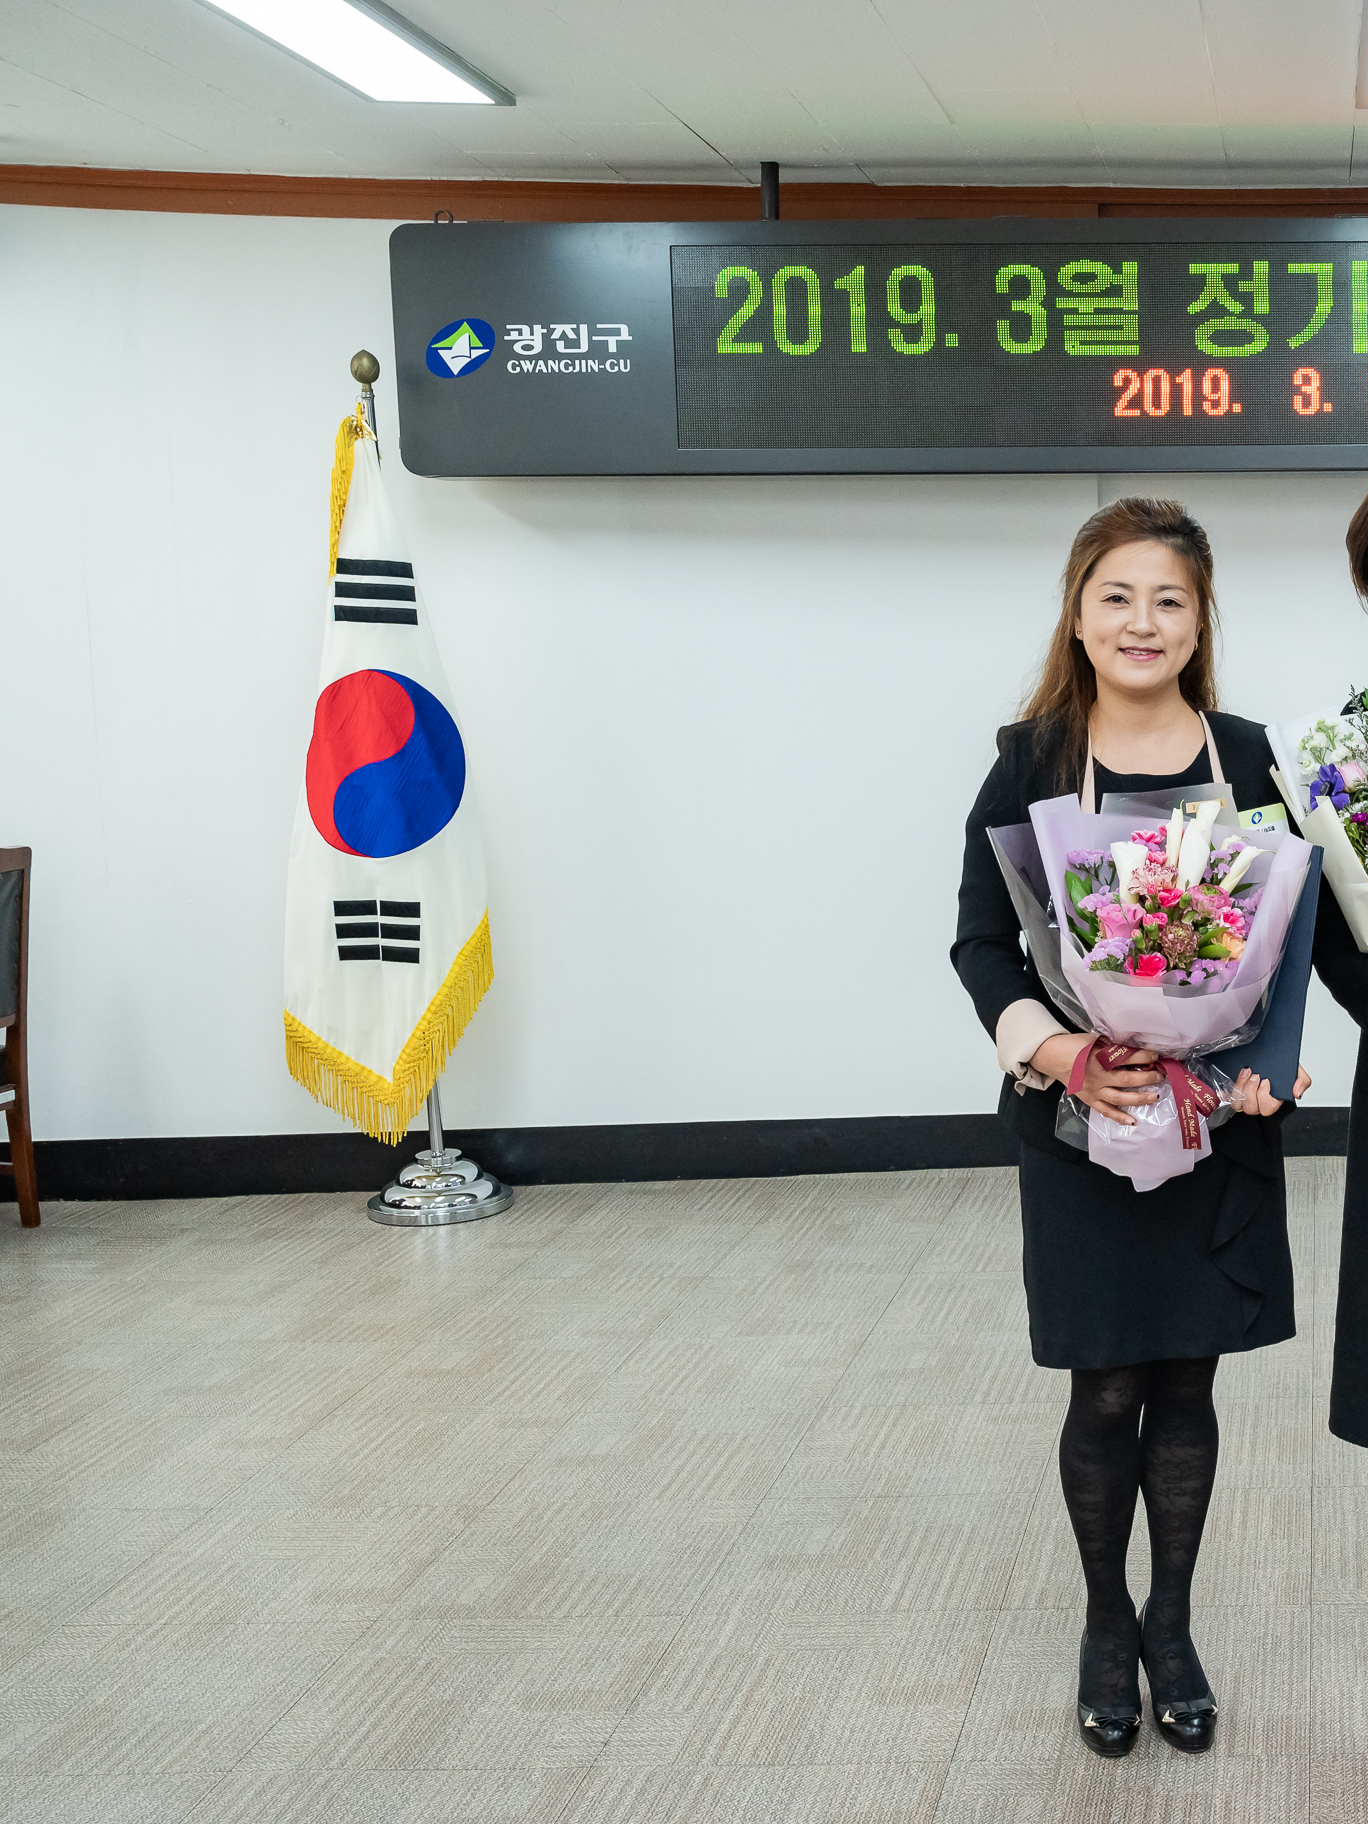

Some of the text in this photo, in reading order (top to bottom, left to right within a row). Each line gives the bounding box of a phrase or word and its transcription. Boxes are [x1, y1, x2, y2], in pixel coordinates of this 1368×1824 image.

[714, 264, 960, 356] 2019.
[995, 259, 1140, 357] 3월
[503, 323, 633, 356] 광진구
[506, 358, 631, 374] GWANGJIN-GU
[1112, 367, 1243, 418] 2019.
[1291, 366, 1334, 417] 3.
[1184, 1098, 1195, 1118] Hand
[1188, 1118, 1198, 1138] Made
